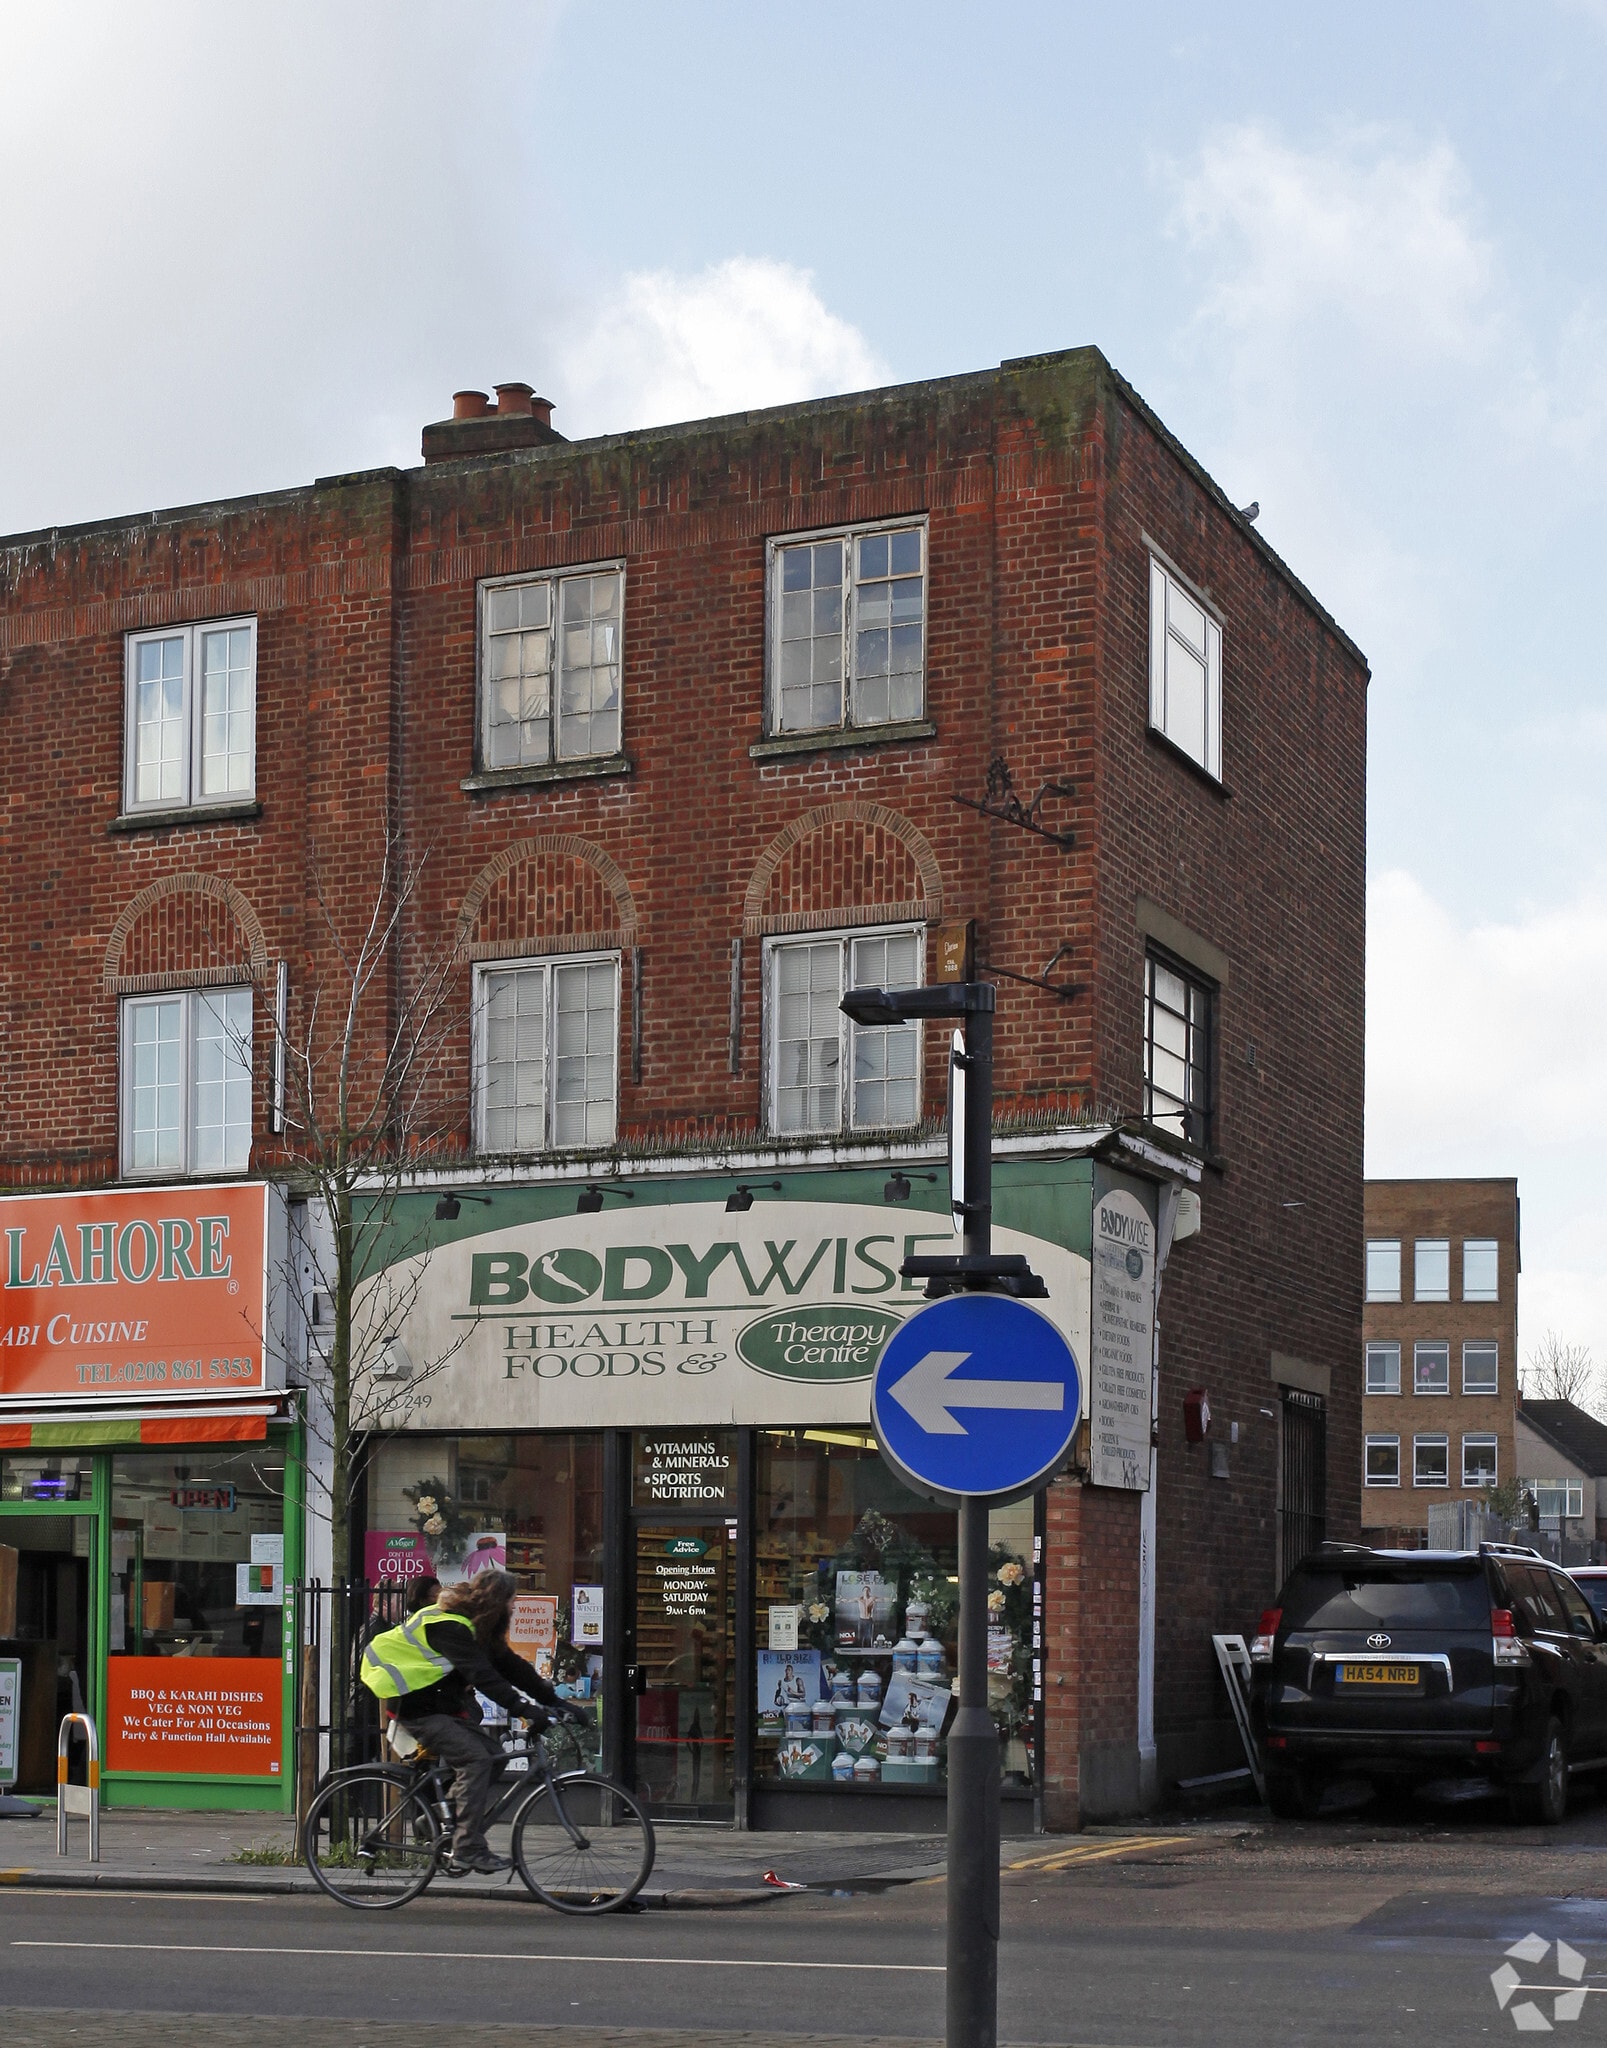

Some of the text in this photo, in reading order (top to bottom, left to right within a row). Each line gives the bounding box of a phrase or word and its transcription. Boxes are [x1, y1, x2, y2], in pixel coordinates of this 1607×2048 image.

[1101, 1207, 1149, 1246] BODYWISE
[5, 1216, 233, 1289] LAHORE
[469, 1233, 954, 1306] BODYWISE
[0, 1325, 41, 1347] ABI
[503, 1319, 718, 1350] HEALTH
[771, 1321, 887, 1346] Therapy
[784, 1344, 870, 1365] Centre
[172, 1360, 202, 1380] 861
[209, 1358, 252, 1378] 5353
[502, 1351, 728, 1379] FOODS &
[404, 1395, 432, 1408] 249
[654, 1443, 716, 1454] VITAMINS
[652, 1456, 729, 1468] & MINERALS
[652, 1473, 701, 1485] SPORTS
[652, 1486, 725, 1498] NUTRITION
[170, 1490, 230, 1508] OPEN
[378, 1559, 424, 1573] COLDS
[656, 1565, 716, 1576] Opening Hours
[663, 1592, 708, 1602] SATURDAY
[536, 1618, 550, 1626] gut
[515, 1627, 549, 1636] feeling?
[1346, 1668, 1416, 1681] HA54 NRB
[131, 1690, 264, 1702] BBQ & KARAHI DISHES
[148, 1704, 242, 1715] VEG & NON VEG
[123, 1716, 271, 1731] We Cater For All Occasions
[122, 1731, 271, 1744] Party & Function Hall Available
